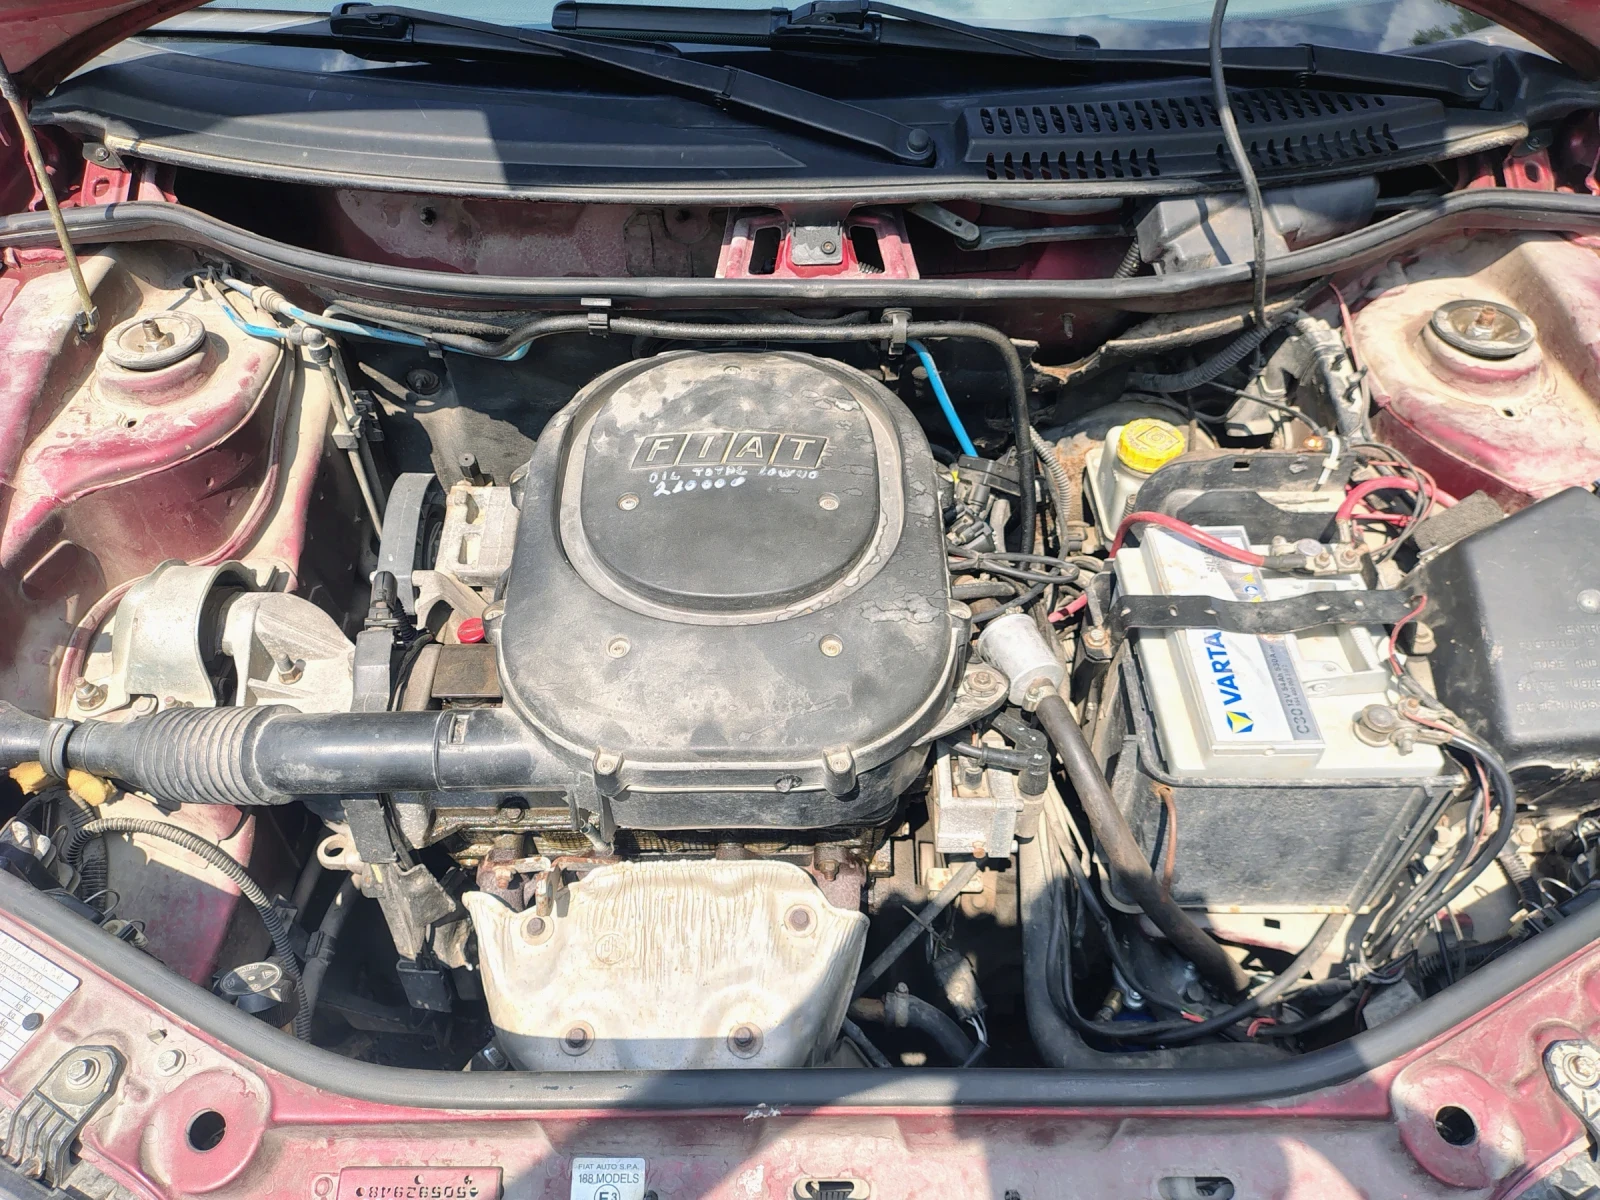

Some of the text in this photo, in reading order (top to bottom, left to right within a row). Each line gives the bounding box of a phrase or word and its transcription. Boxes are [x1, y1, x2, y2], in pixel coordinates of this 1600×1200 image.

[645, 436, 816, 462] FIAT
[649, 471, 681, 484] OIL
[692, 465, 748, 477] TOTAL
[1204, 631, 1242, 706] VARTA
[1291, 708, 1310, 734] C30
[579, 1173, 639, 1184] 188 MODELS
